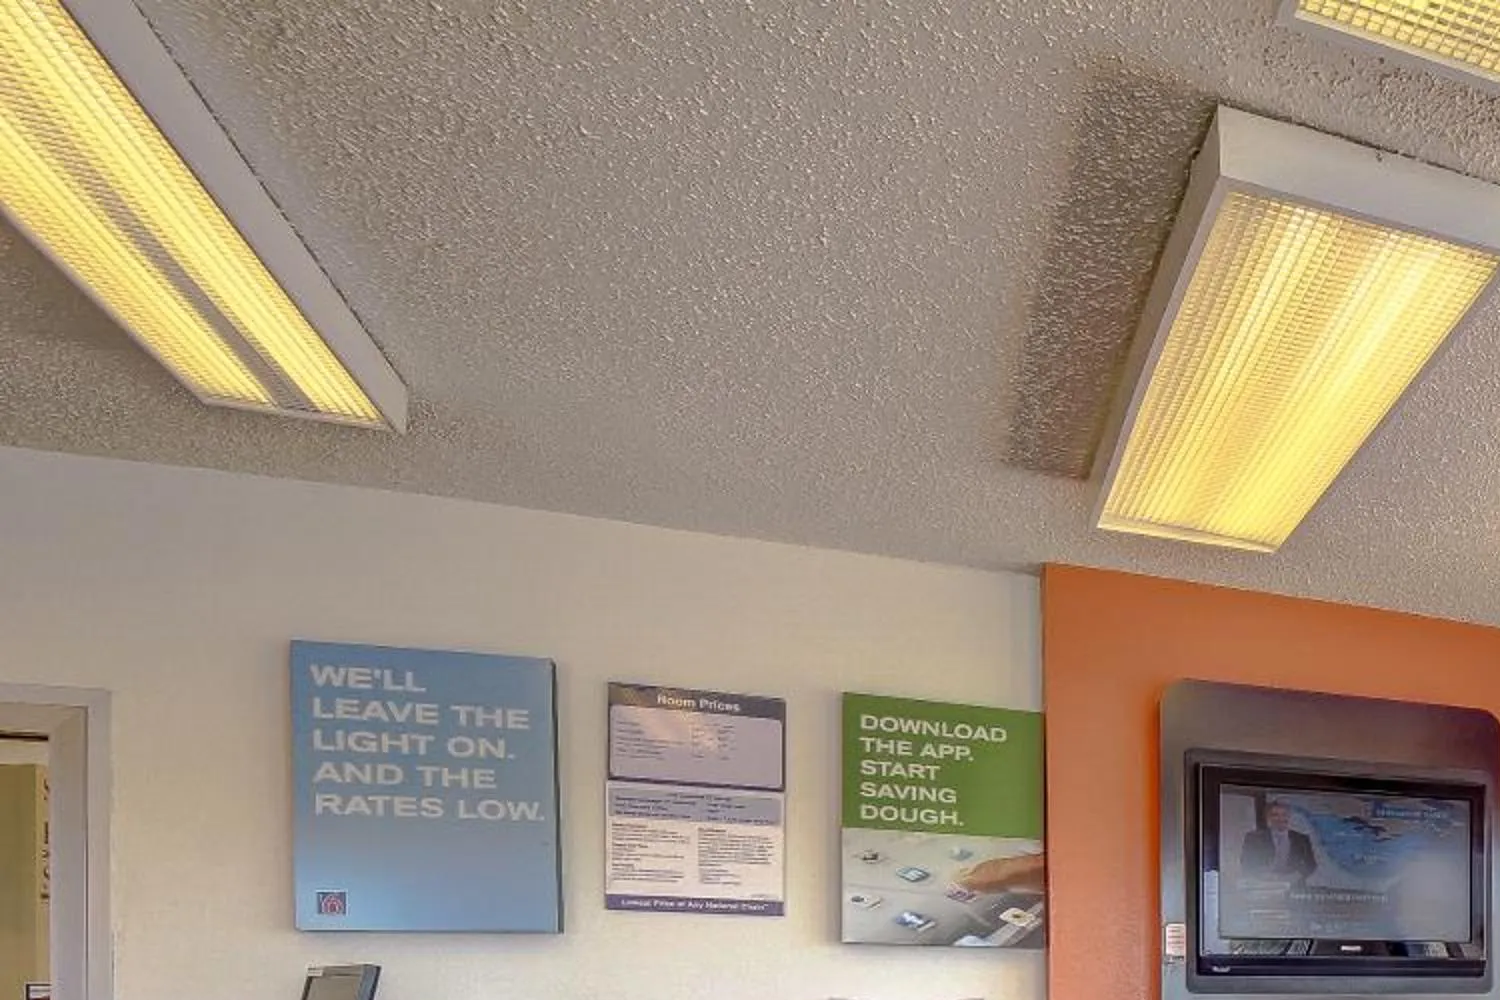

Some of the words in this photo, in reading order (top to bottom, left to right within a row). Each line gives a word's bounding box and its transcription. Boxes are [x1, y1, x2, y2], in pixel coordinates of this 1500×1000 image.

[310, 664, 426, 692] WE'LL
[312, 697, 439, 724] LEAVE
[451, 705, 529, 729] THE
[859, 714, 1007, 742] DOWNLOAD
[312, 729, 434, 755] LIGHT
[446, 736, 515, 760] ON.
[859, 737, 912, 756] THE
[919, 743, 974, 762] APP.
[312, 761, 404, 785] AND
[415, 766, 497, 789] THE
[860, 759, 941, 780] START
[314, 793, 444, 818] RATES
[458, 799, 545, 821] LOW.
[860, 782, 957, 804] SAVING
[860, 804, 964, 827] DOUGH.
